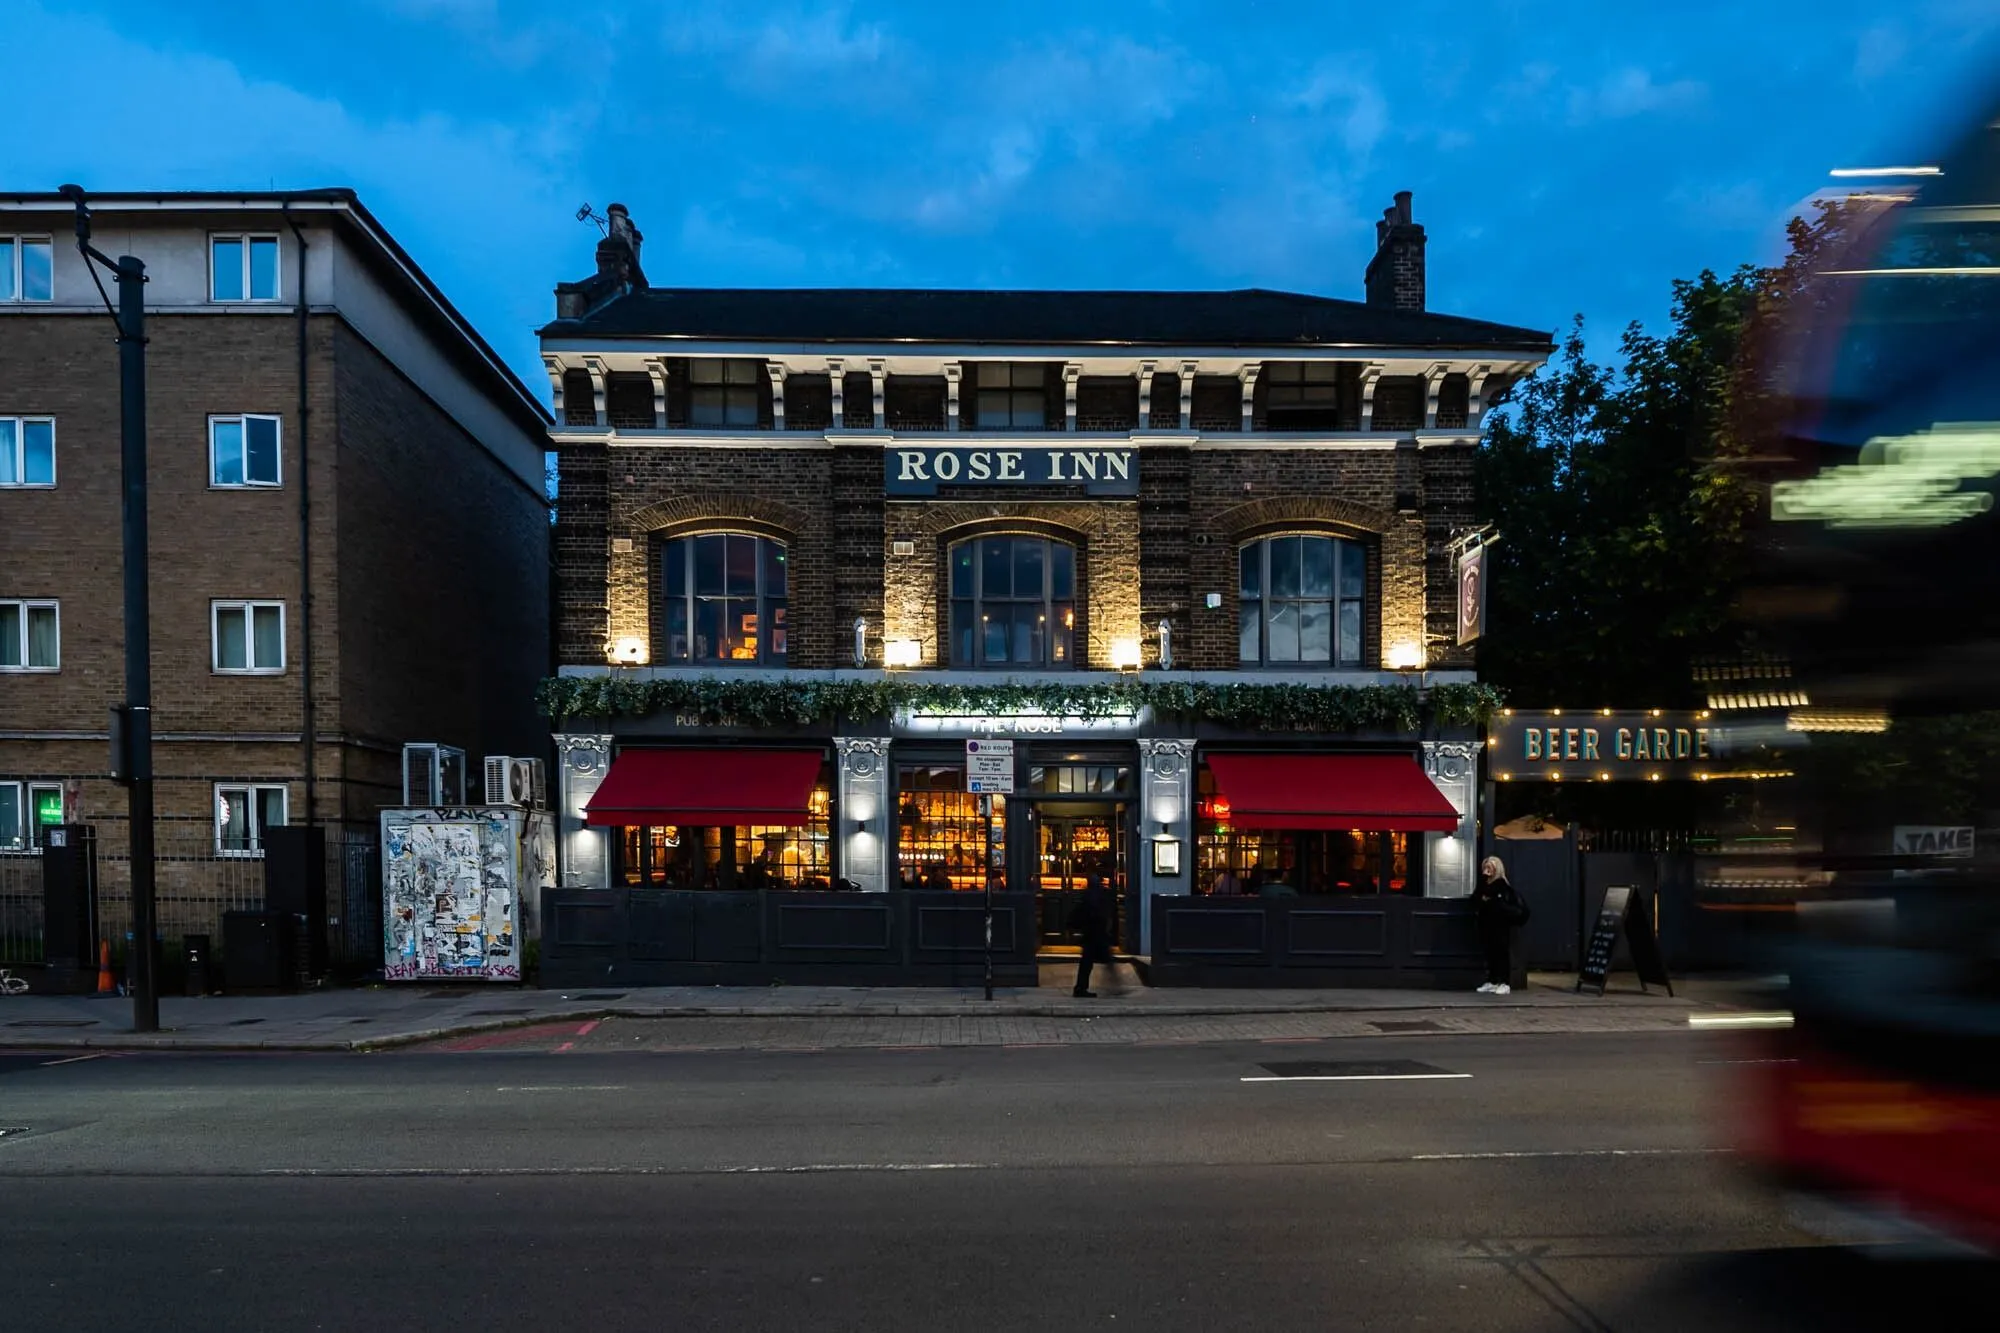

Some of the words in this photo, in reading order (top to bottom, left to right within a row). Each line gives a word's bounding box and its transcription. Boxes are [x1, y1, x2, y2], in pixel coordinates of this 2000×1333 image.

[898, 452, 1025, 480] ROSE
[1048, 452, 1131, 480] INN
[676, 715, 699, 727] PUB
[971, 718, 1005, 733] THE
[1014, 718, 1063, 733] ROSE
[1525, 727, 1600, 760] BEER
[1906, 829, 1972, 853] TAKE
